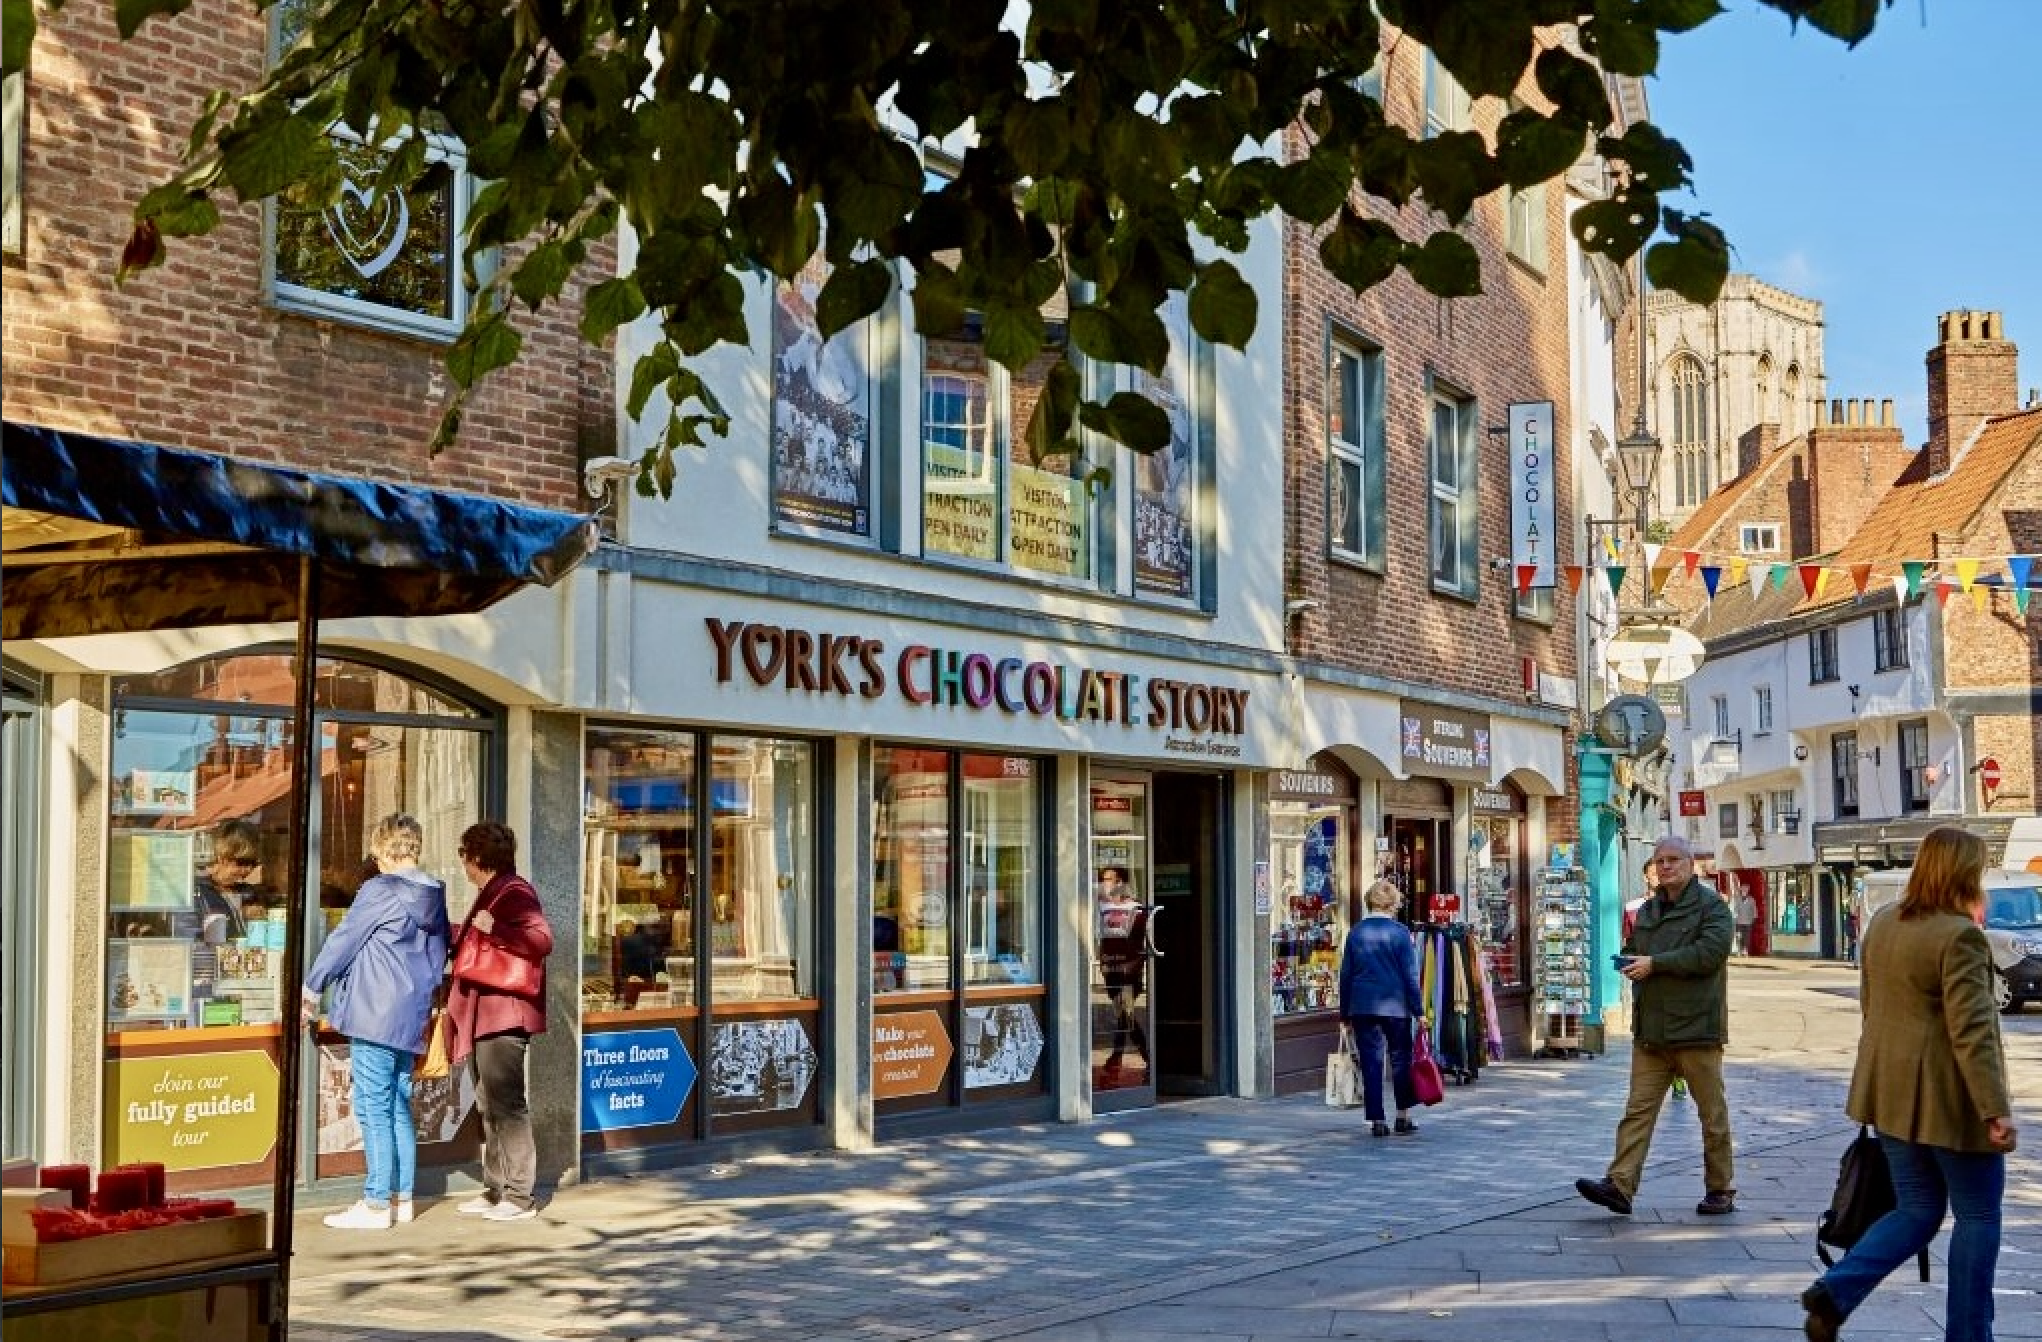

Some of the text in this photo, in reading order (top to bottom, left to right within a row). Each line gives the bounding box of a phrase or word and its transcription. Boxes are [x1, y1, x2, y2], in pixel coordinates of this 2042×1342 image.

[927, 462, 978, 478] VISIT
[954, 523, 988, 543] DAILY
[1011, 535, 1079, 563] OPEN DAILY
[704, 617, 1251, 735] YORK'S CHOCOLATE STORY
[875, 1026, 904, 1043] Make
[584, 1044, 669, 1067] Three floors
[884, 1043, 935, 1061] chocolate
[153, 1069, 229, 1094] Join our
[128, 1091, 257, 1126] fully guided
[609, 1091, 645, 1111] facts
[172, 1130, 209, 1147] tour
